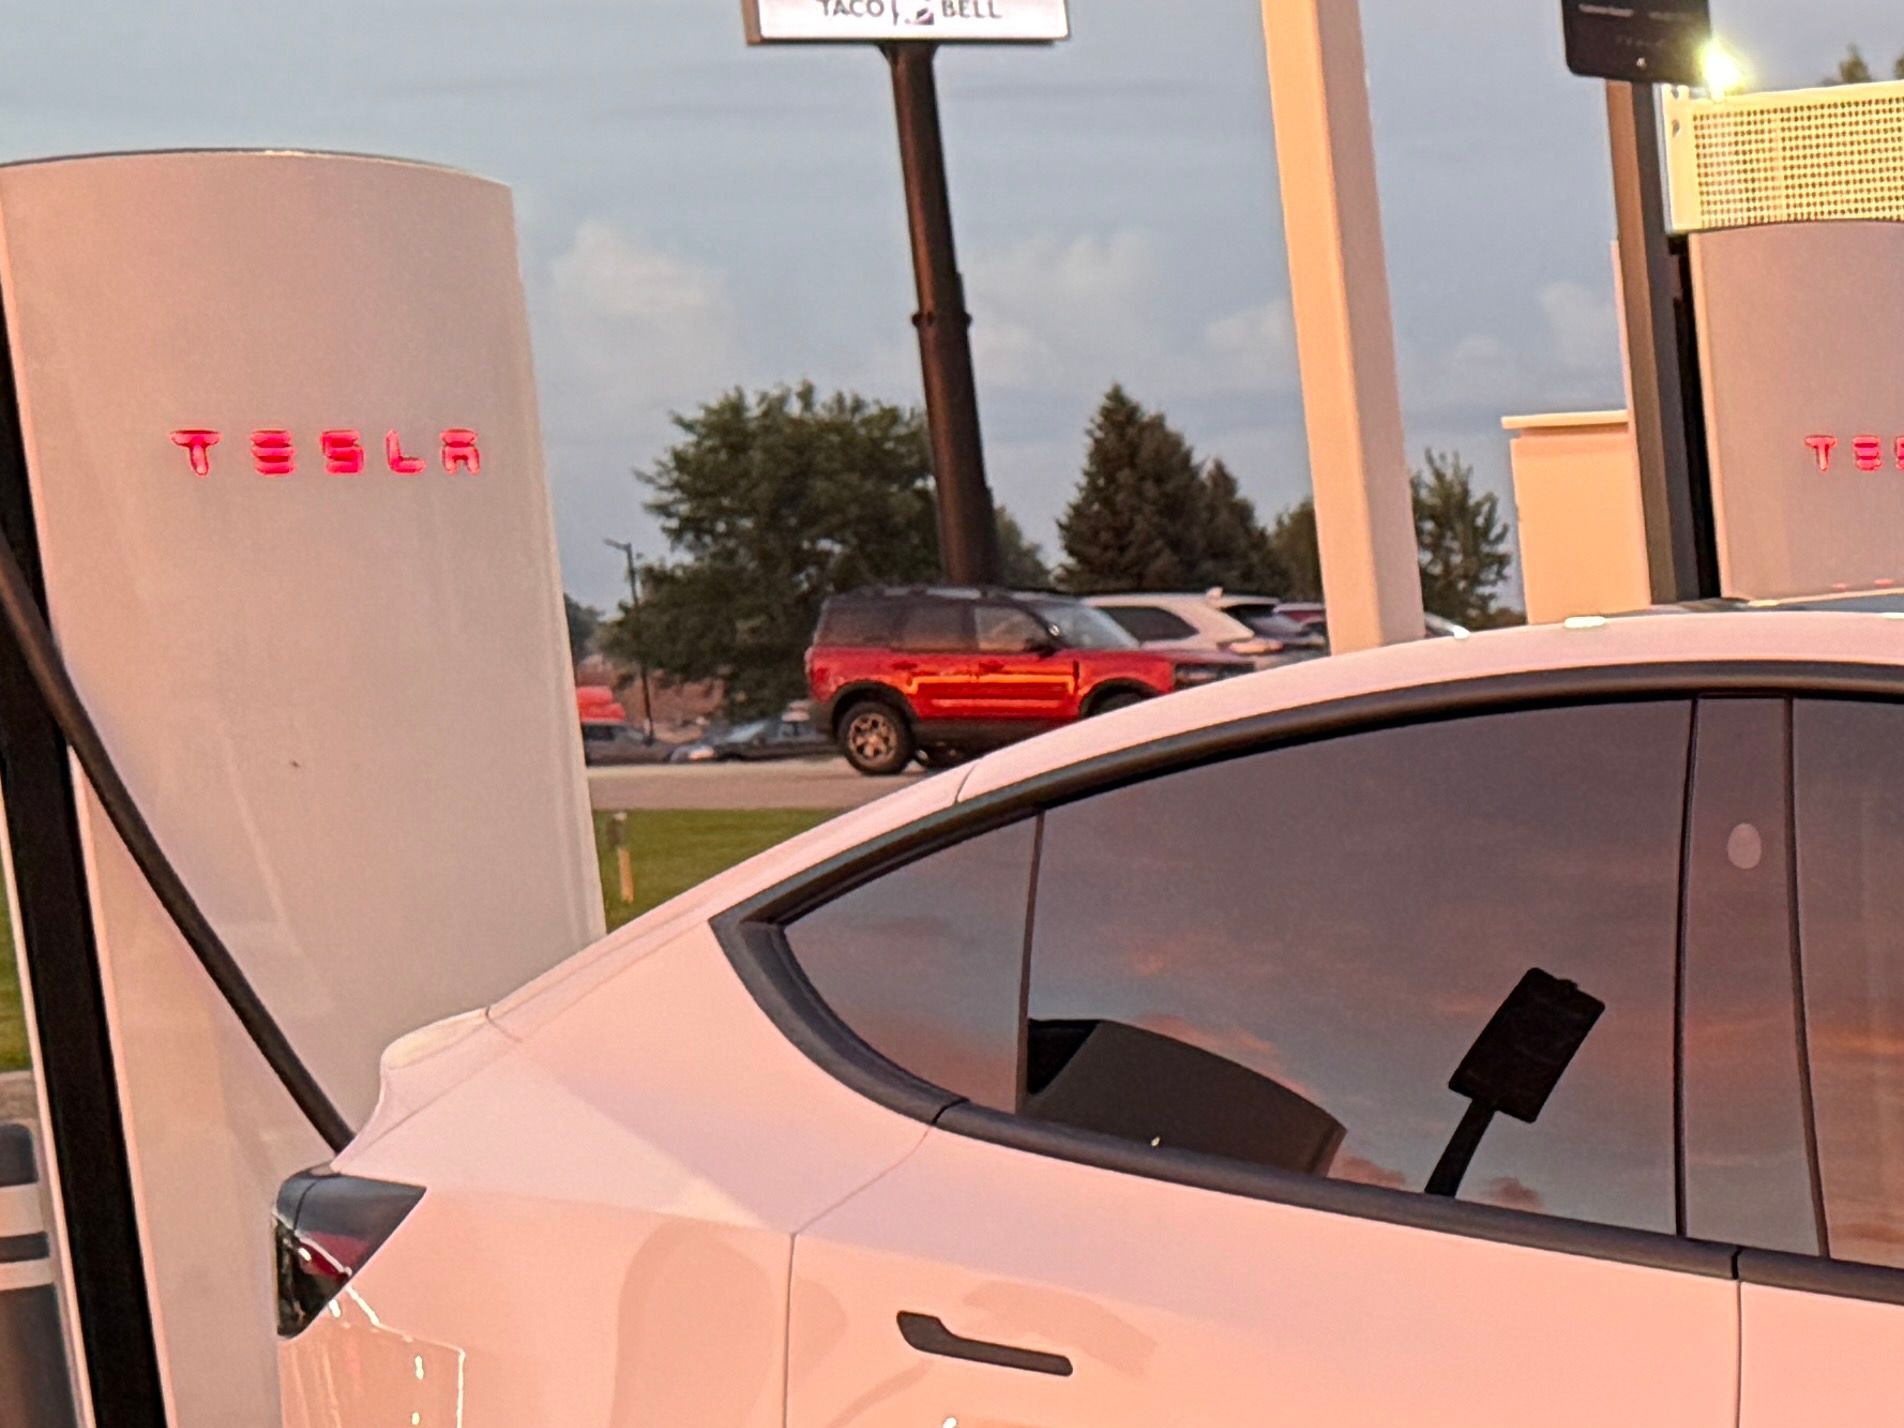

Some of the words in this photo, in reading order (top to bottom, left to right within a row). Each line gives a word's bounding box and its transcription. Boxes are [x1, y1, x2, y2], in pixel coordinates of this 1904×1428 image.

[817, 0, 885, 17] TACO
[942, 0, 1003, 18] BELL
[170, 429, 480, 475] TESLA
